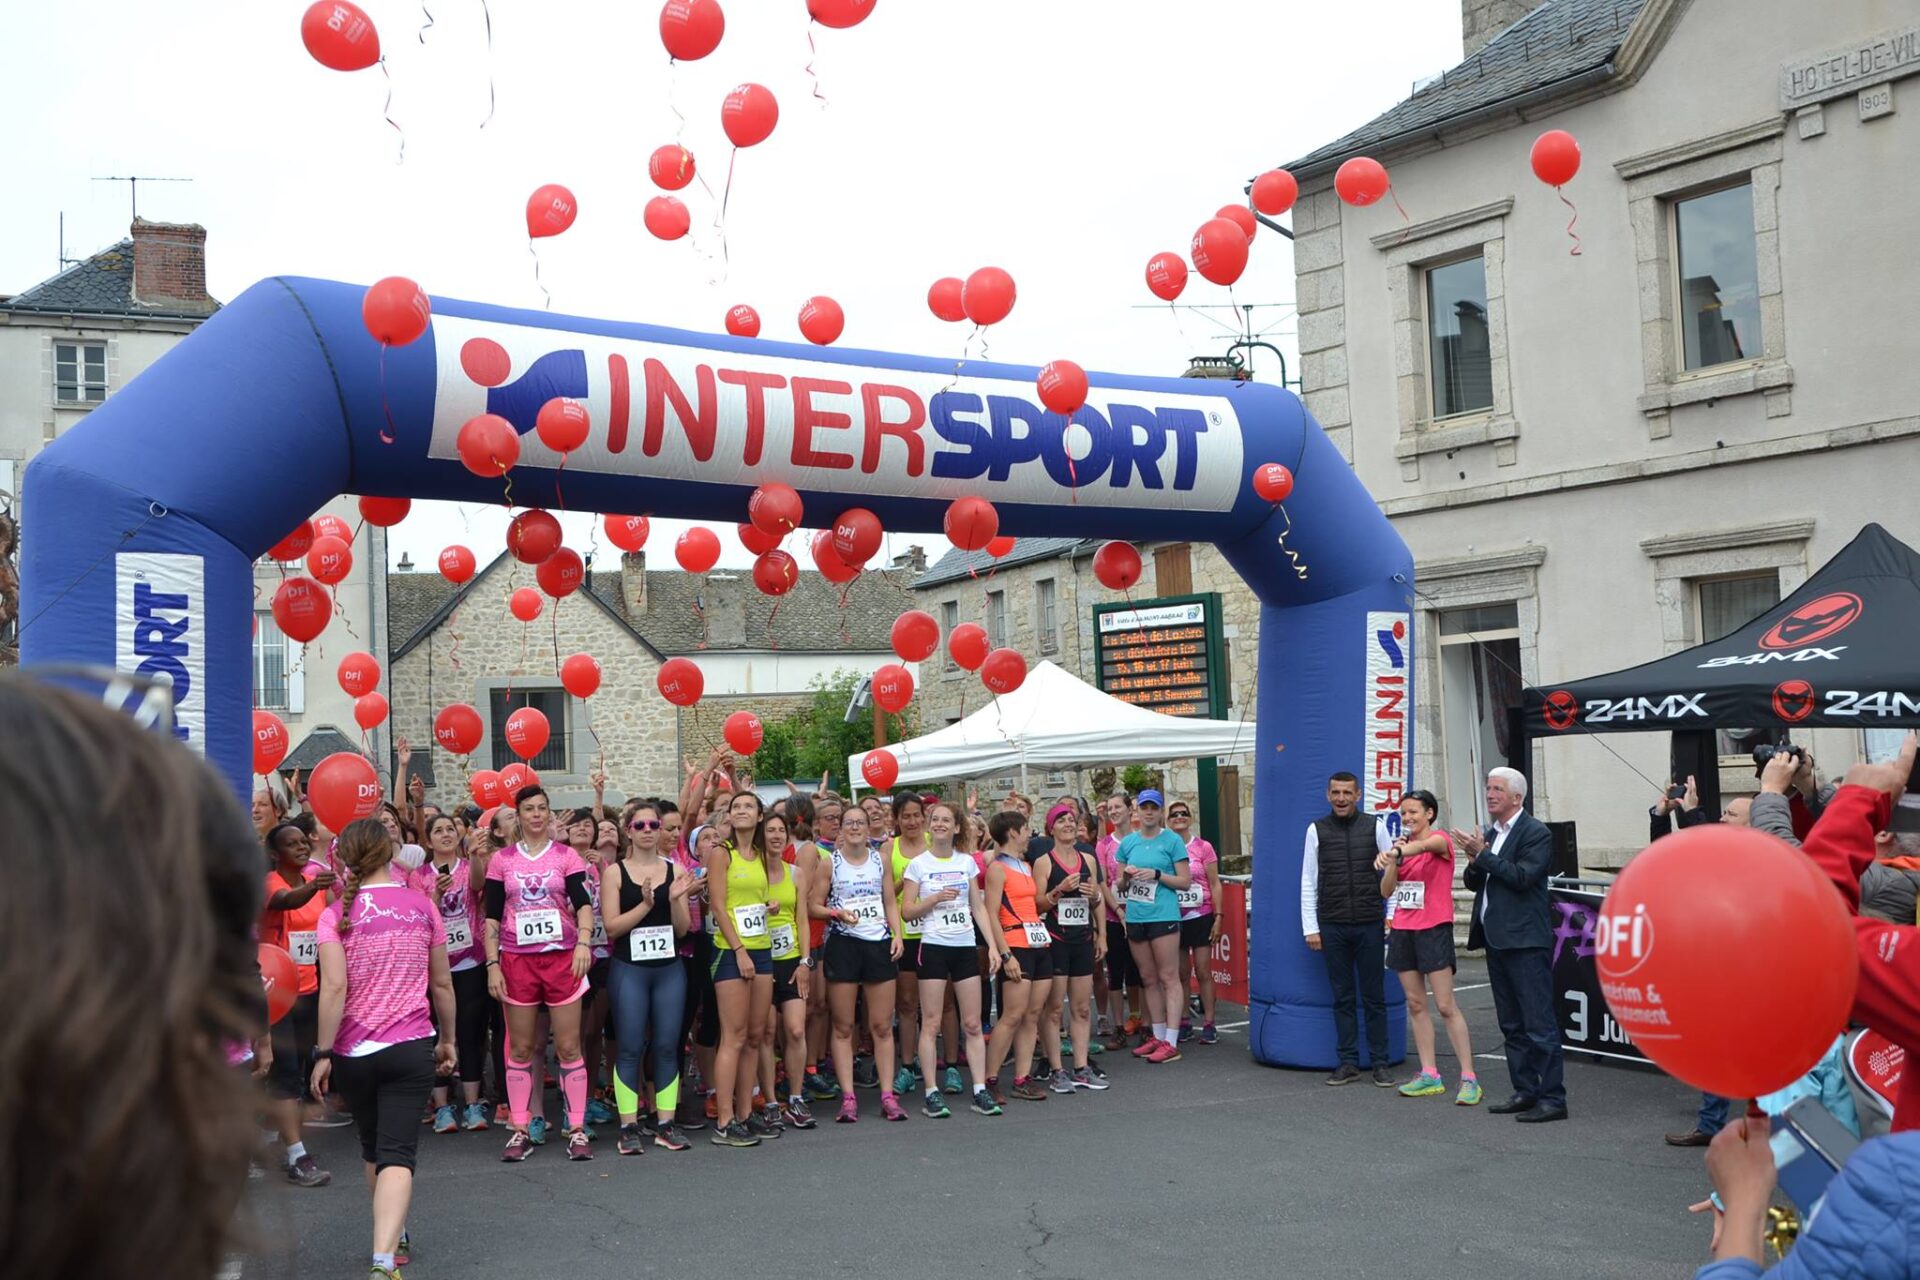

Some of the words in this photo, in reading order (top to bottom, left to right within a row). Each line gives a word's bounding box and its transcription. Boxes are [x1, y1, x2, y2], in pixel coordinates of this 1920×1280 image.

[1791, 32, 1920, 96] HOTEL-DE-VIL
[1861, 92, 1889, 112] 1903
[606, 353, 1209, 490] INTERSPORT
[1697, 646, 1849, 669] 24MX
[1585, 692, 1710, 724] 24MX
[1823, 690, 1920, 717] 24M
[1132, 886, 1151, 898] 062
[1397, 890, 1418, 902] 001
[942, 912, 966, 926] 148
[1065, 907, 1086, 919] 002
[524, 921, 554, 936] 015
[447, 930, 465, 945] 36
[639, 938, 667, 953] 112
[773, 936, 790, 951] 53
[1030, 932, 1047, 943] 003
[1211, 968, 1232, 986] ranée
[1647, 984, 1663, 1004] &
[1564, 989, 1588, 1042] 3
